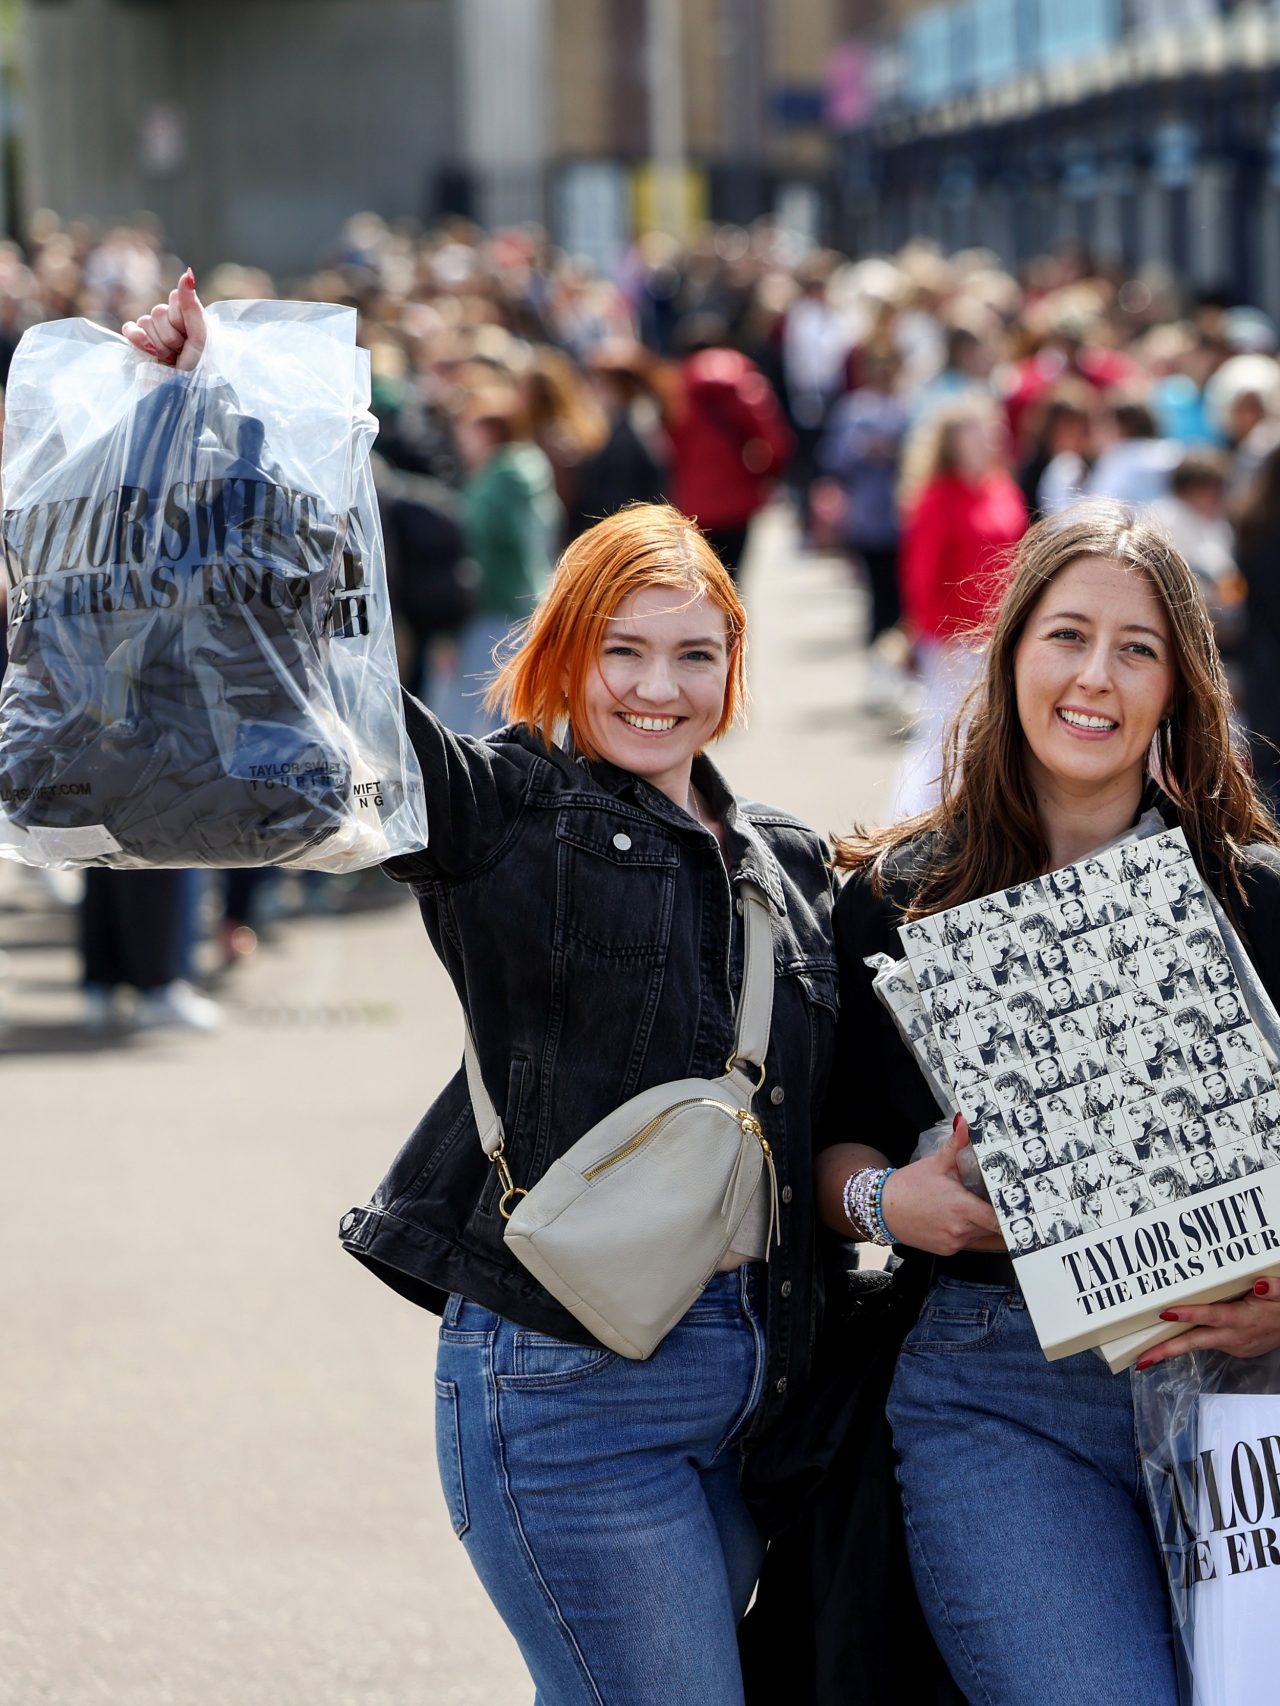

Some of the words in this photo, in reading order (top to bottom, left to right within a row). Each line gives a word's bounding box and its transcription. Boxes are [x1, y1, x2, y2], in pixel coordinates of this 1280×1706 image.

[63, 565, 178, 617] ERAS
[249, 763, 299, 776] TAYLOR
[1061, 1220, 1180, 1295] TAYLOR
[1178, 1185, 1270, 1253] SWIFT
[1076, 1281, 1133, 1316] THE
[1136, 1255, 1205, 1296] ERAS
[1207, 1228, 1280, 1269] TOUR
